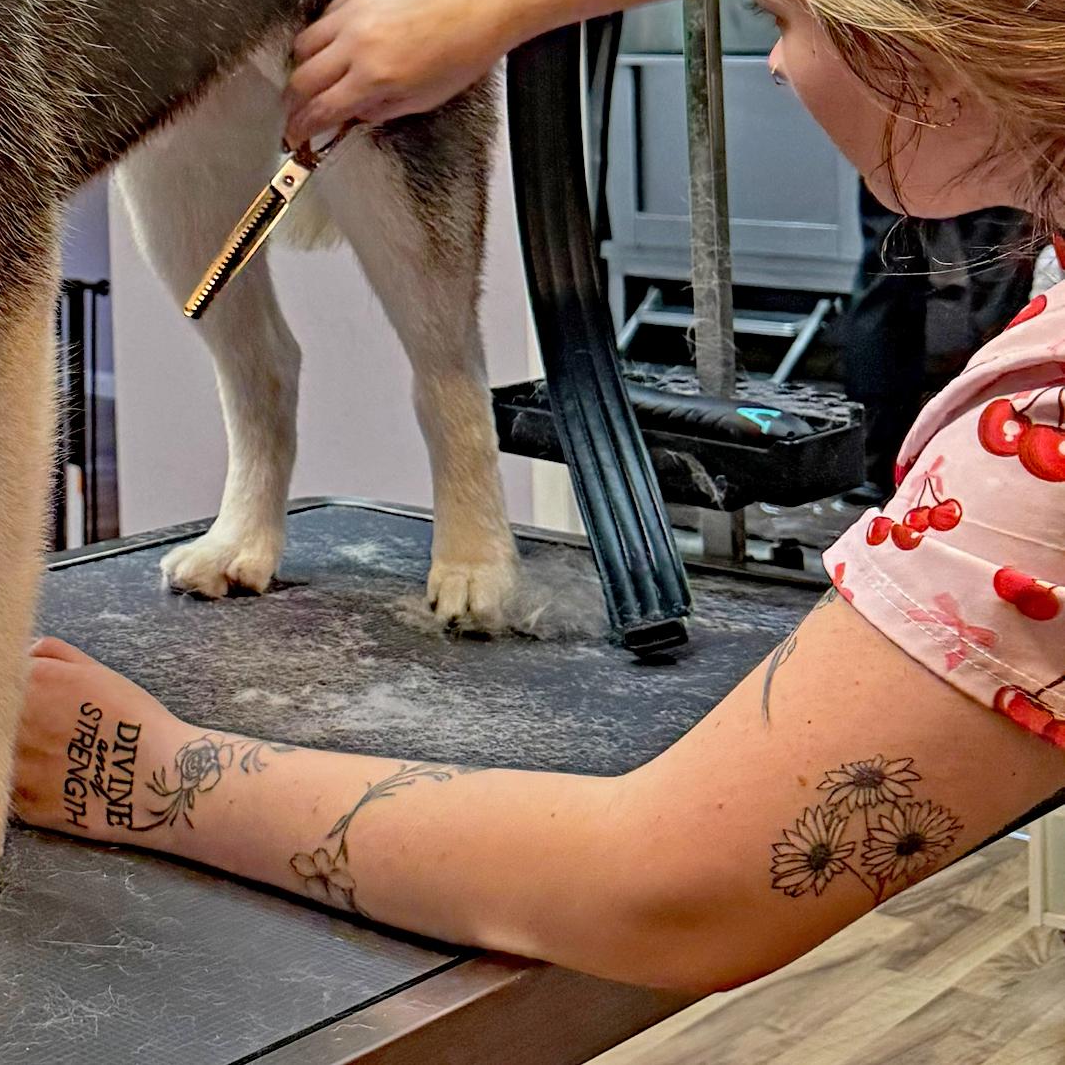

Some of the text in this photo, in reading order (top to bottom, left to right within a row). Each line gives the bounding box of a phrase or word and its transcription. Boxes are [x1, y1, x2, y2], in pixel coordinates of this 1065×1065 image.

[64, 702, 103, 829] STRENGTH
[89, 738, 115, 802] and
[106, 721, 142, 831] DIVINE
